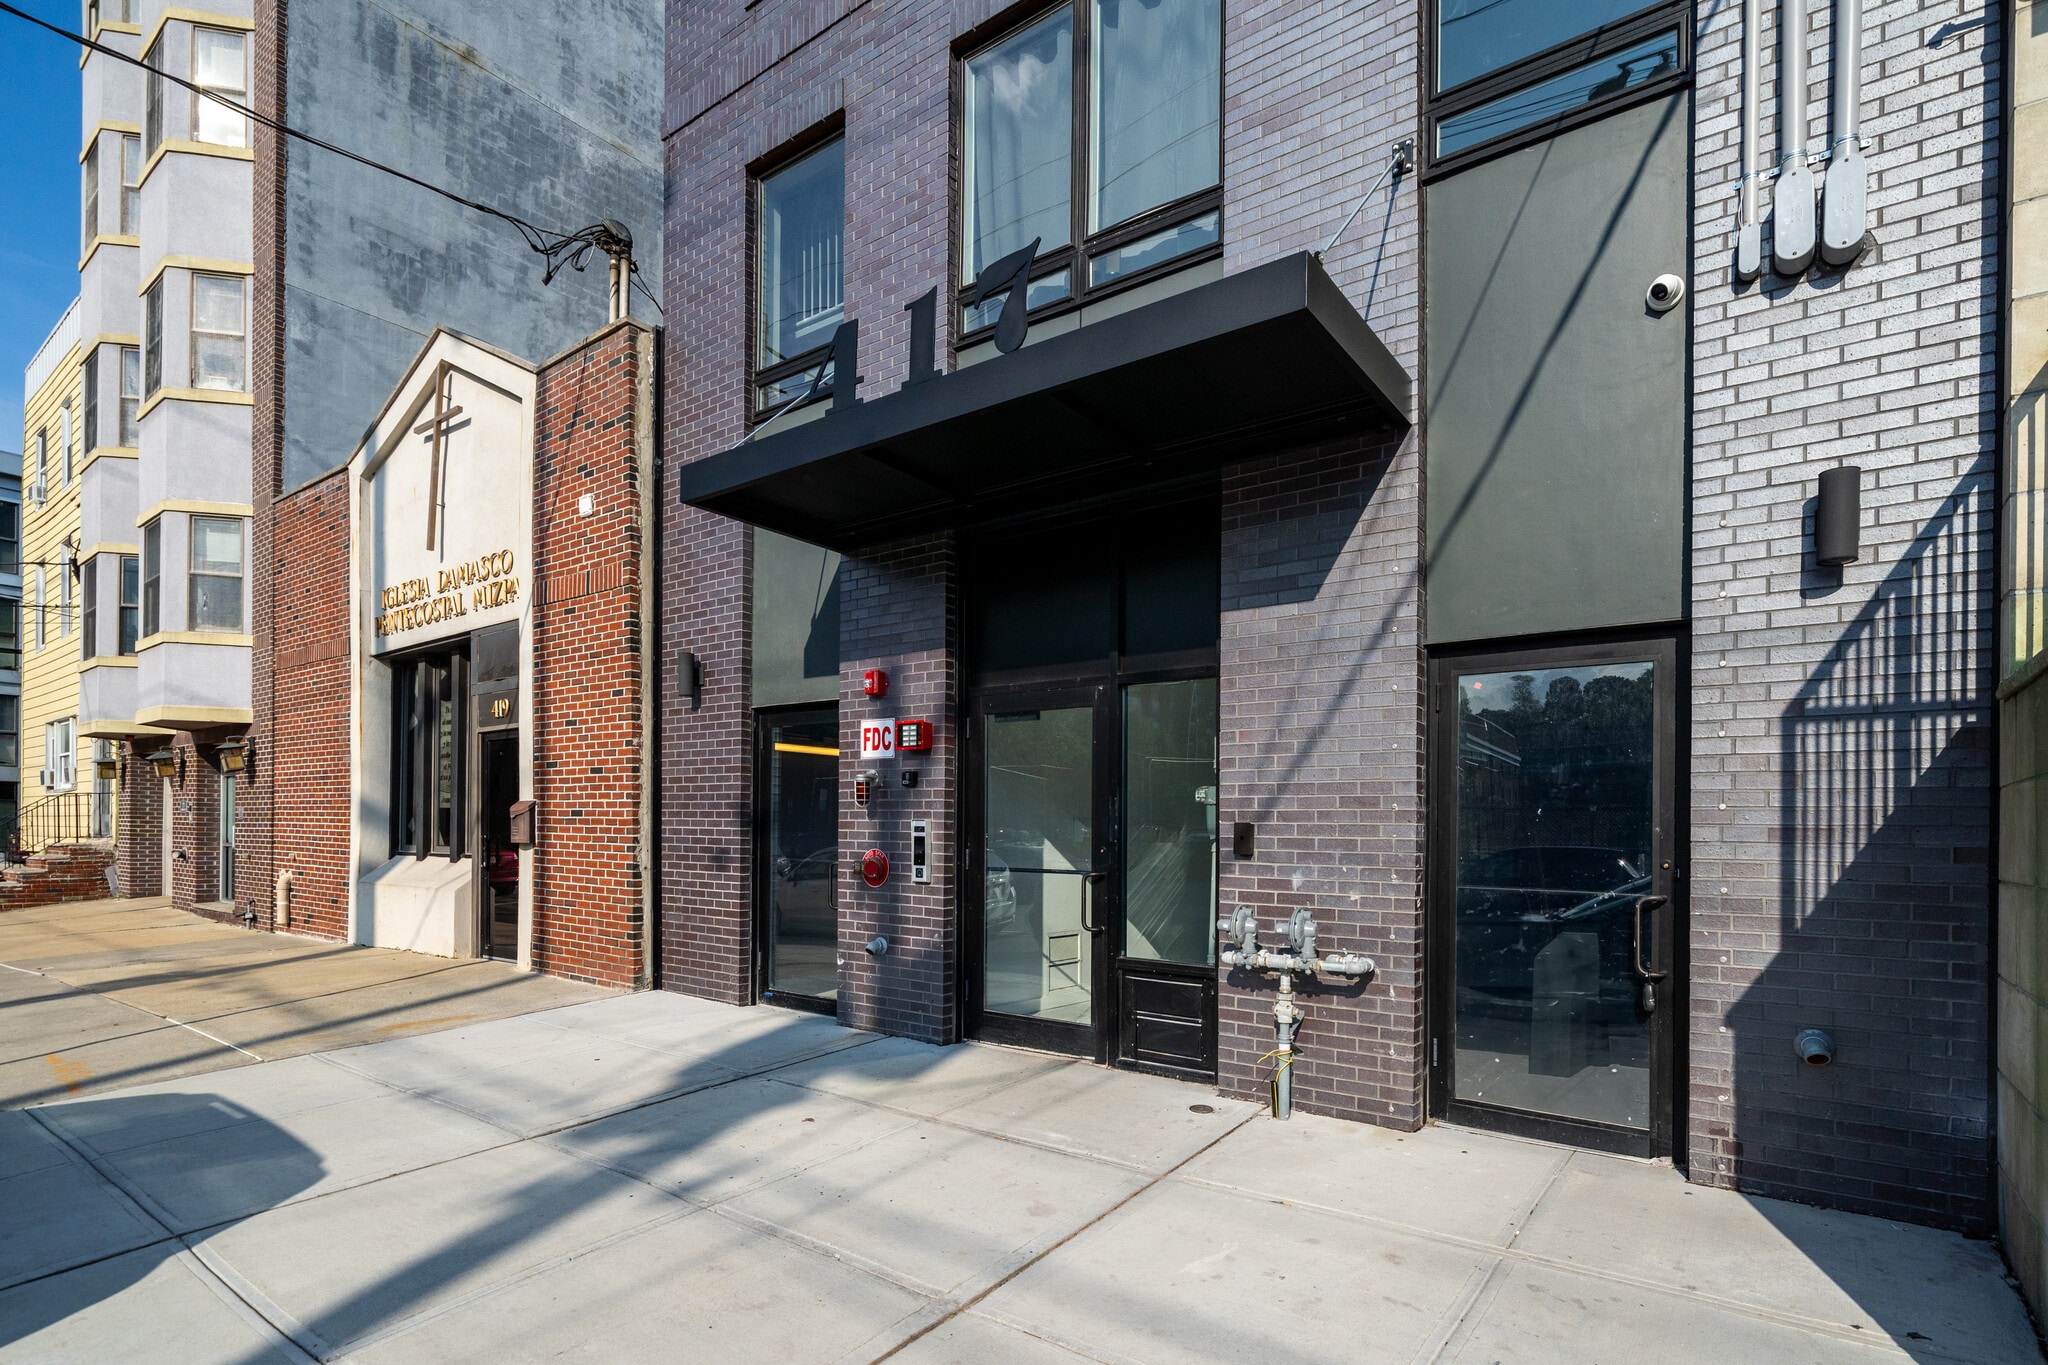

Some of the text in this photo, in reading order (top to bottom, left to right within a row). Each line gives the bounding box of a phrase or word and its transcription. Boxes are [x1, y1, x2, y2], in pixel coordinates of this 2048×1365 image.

[808, 236, 1041, 416] 417
[374, 576, 520, 638] PENTECOSTAL MIZPA
[381, 549, 514, 611] IGLESIA DAMASCO
[491, 698, 510, 718] 419
[863, 726, 892, 752] FDC
